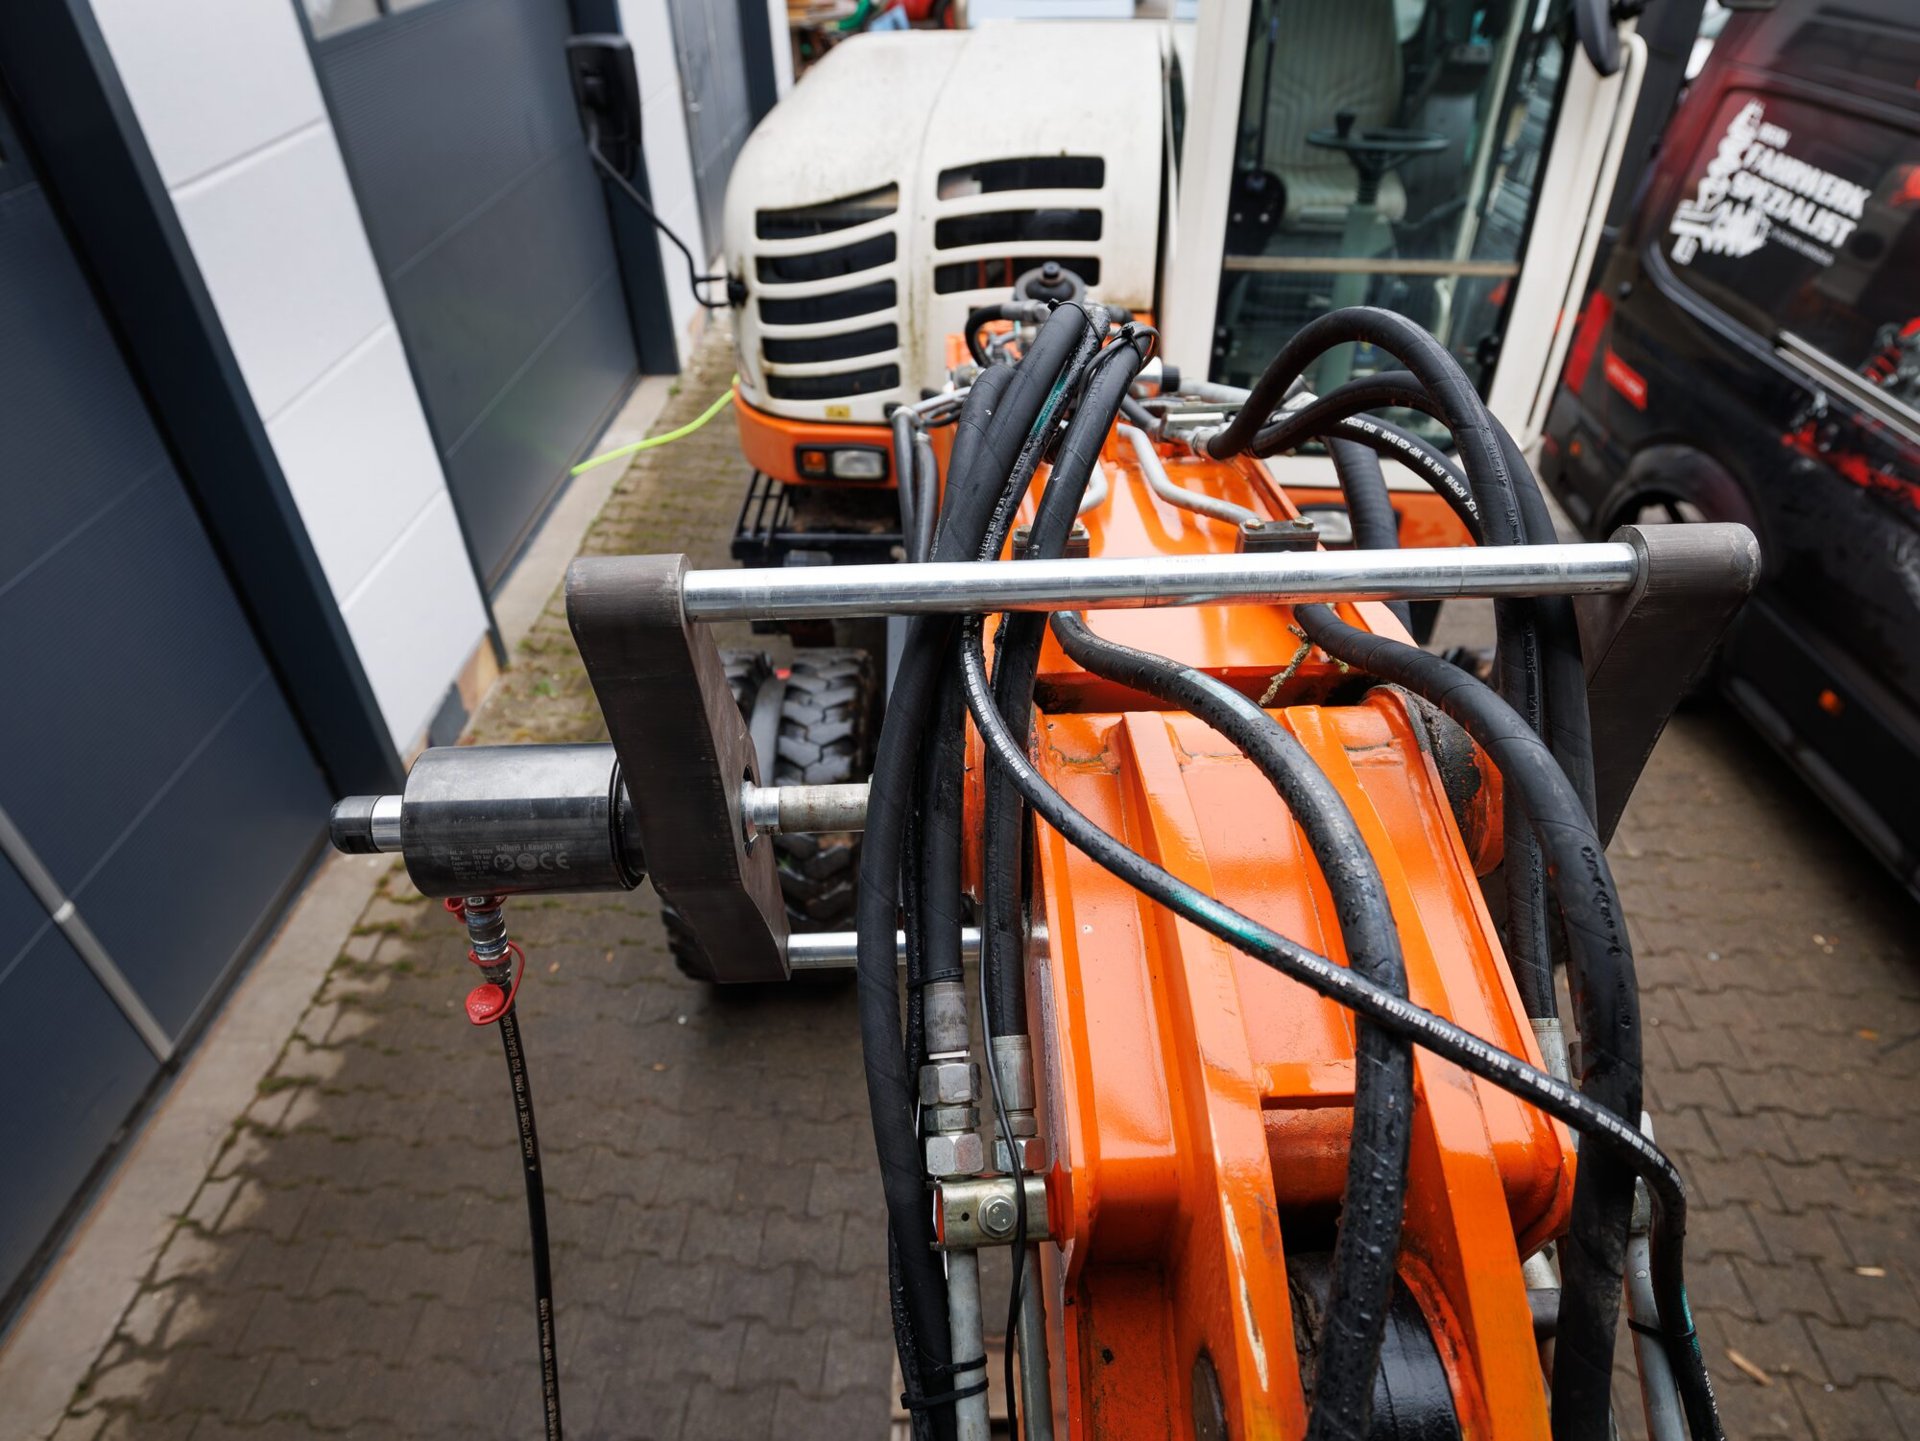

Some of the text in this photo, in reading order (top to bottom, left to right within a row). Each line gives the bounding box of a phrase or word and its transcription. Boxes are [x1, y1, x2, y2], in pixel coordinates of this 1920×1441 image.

[1730, 169, 1857, 248] SPEZIALIST
[1363, 423, 1379, 435] ISO
[1381, 429, 1400, 445] BAR
[1408, 445, 1424, 460] WP
[1423, 456, 1435, 467] 16
[1431, 463, 1446, 477] DN
[1444, 474, 1468, 499] KP616
[512, 1058, 522, 1074] 700
[520, 1111, 531, 1136] HOSE
